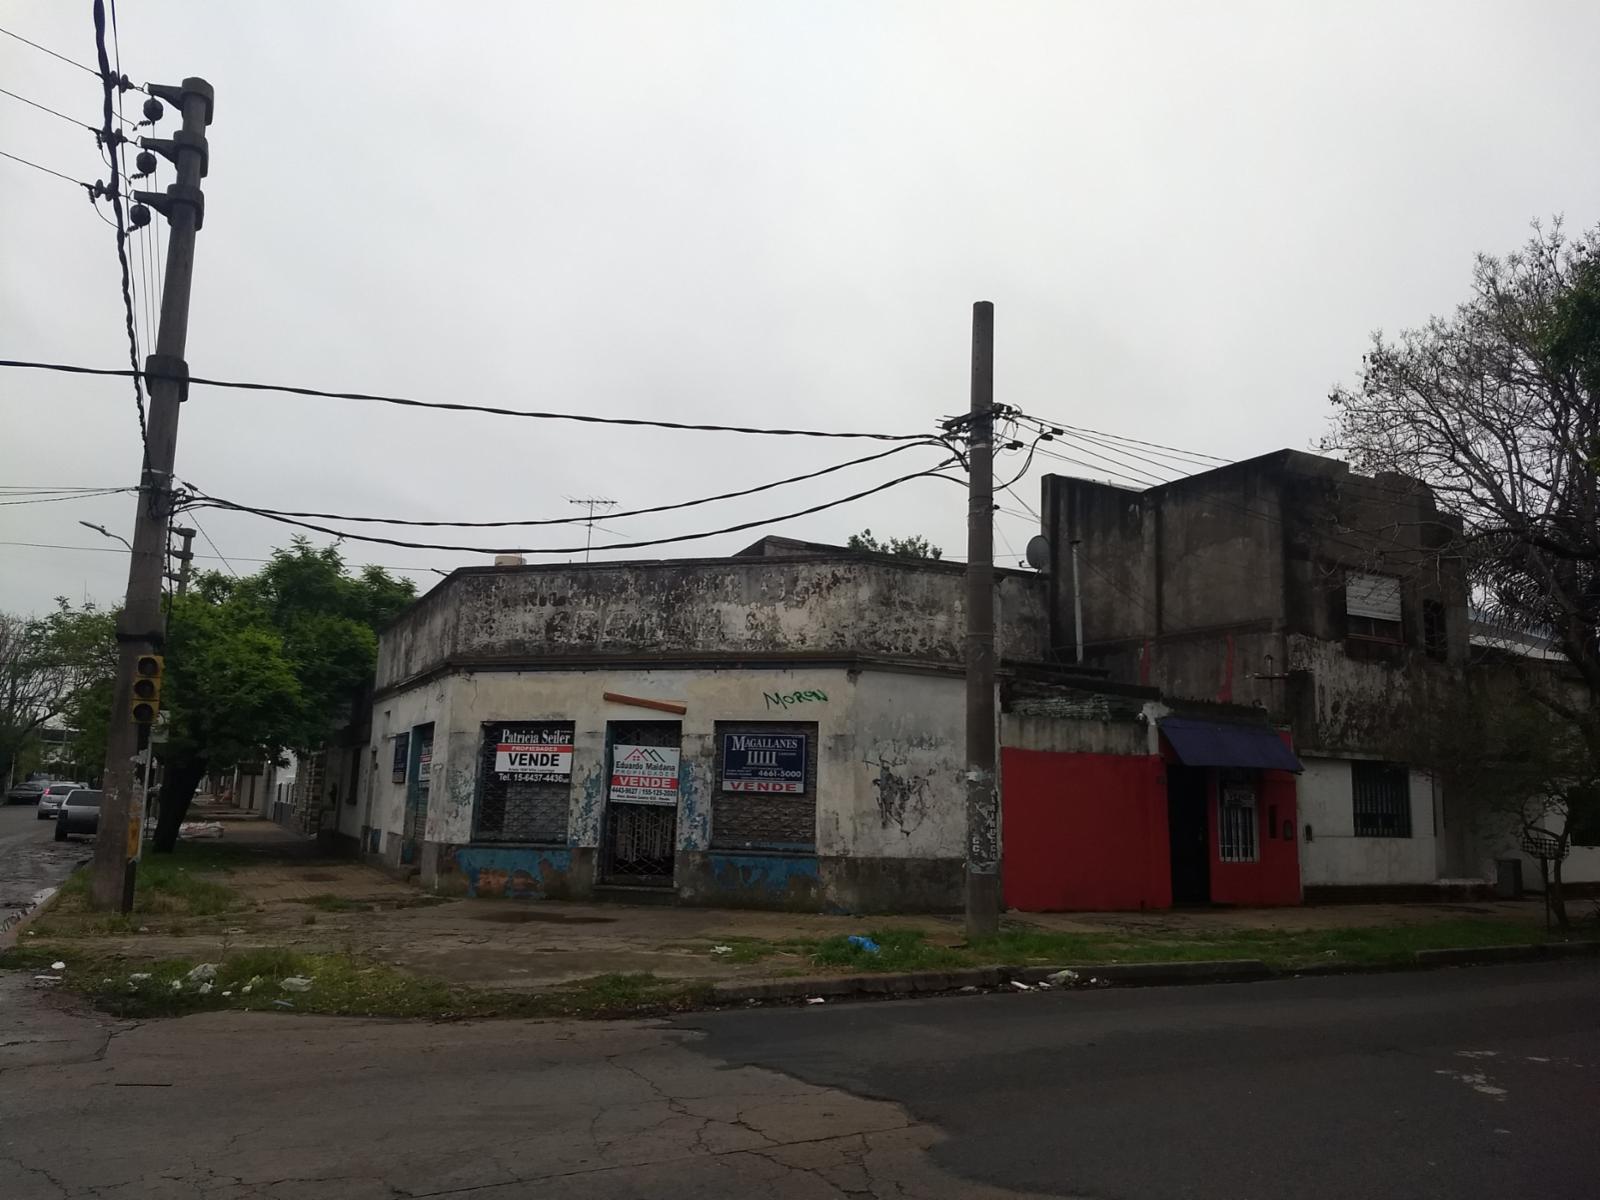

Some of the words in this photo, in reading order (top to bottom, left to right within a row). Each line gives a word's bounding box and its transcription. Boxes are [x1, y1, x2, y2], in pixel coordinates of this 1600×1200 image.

[502, 728, 539, 743] Patricia
[541, 729, 571, 744] Seiler
[508, 753, 560, 767] VENDE
[615, 761, 643, 770] Eduardo
[645, 763, 676, 772] Maidana
[615, 769, 676, 777] PROPIEDADES
[619, 776, 671, 788] VENDE
[730, 782, 797, 792] VENDE
